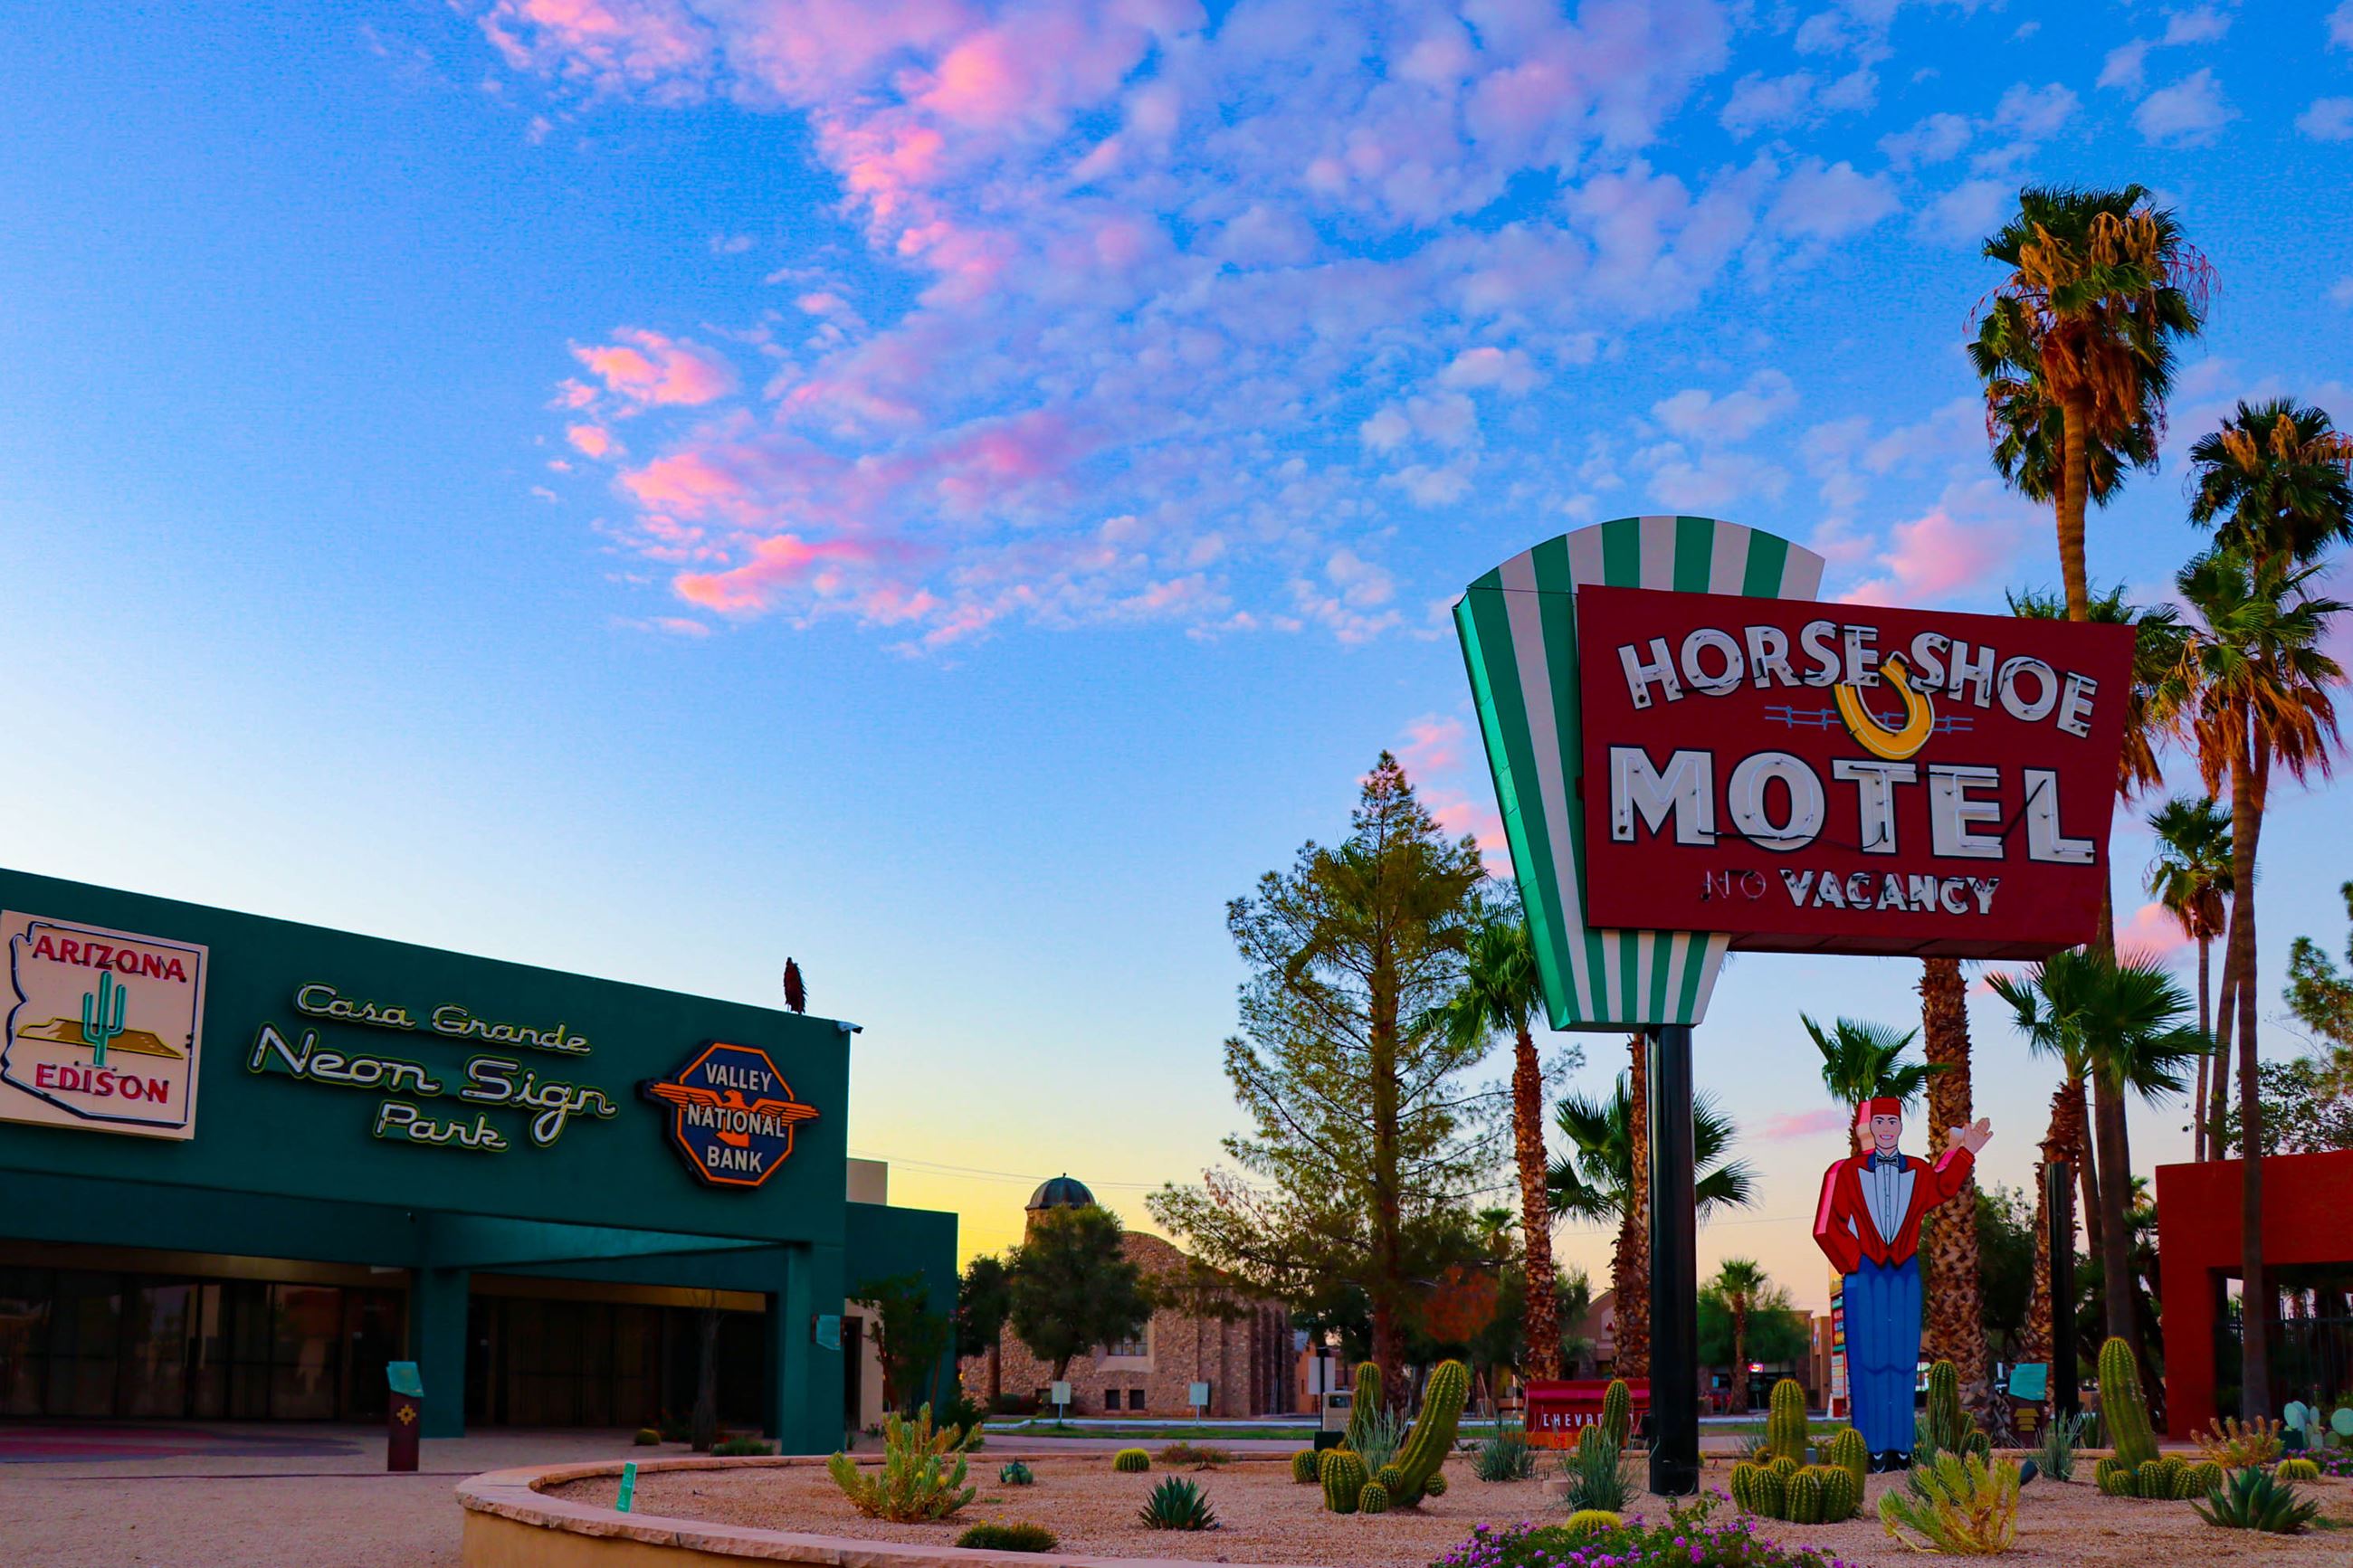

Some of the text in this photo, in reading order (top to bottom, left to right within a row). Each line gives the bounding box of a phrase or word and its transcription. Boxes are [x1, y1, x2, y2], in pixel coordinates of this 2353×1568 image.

[1618, 621, 2098, 737] HORSE SHOE
[1611, 746, 2094, 863] MOTEL
[1702, 870, 1999, 914] NO VACANCY
[33, 936, 186, 983] ARIZONA
[295, 983, 591, 1055] Casa Grande
[34, 1063, 168, 1103] EDISON
[248, 1022, 618, 1146] Neon Sign
[705, 1062, 772, 1092] VALLEY
[374, 1099, 509, 1152] Park
[687, 1103, 786, 1137] NATIONAL
[707, 1145, 763, 1173] BANK
[1543, 1413, 1634, 1427] CHEVRO
